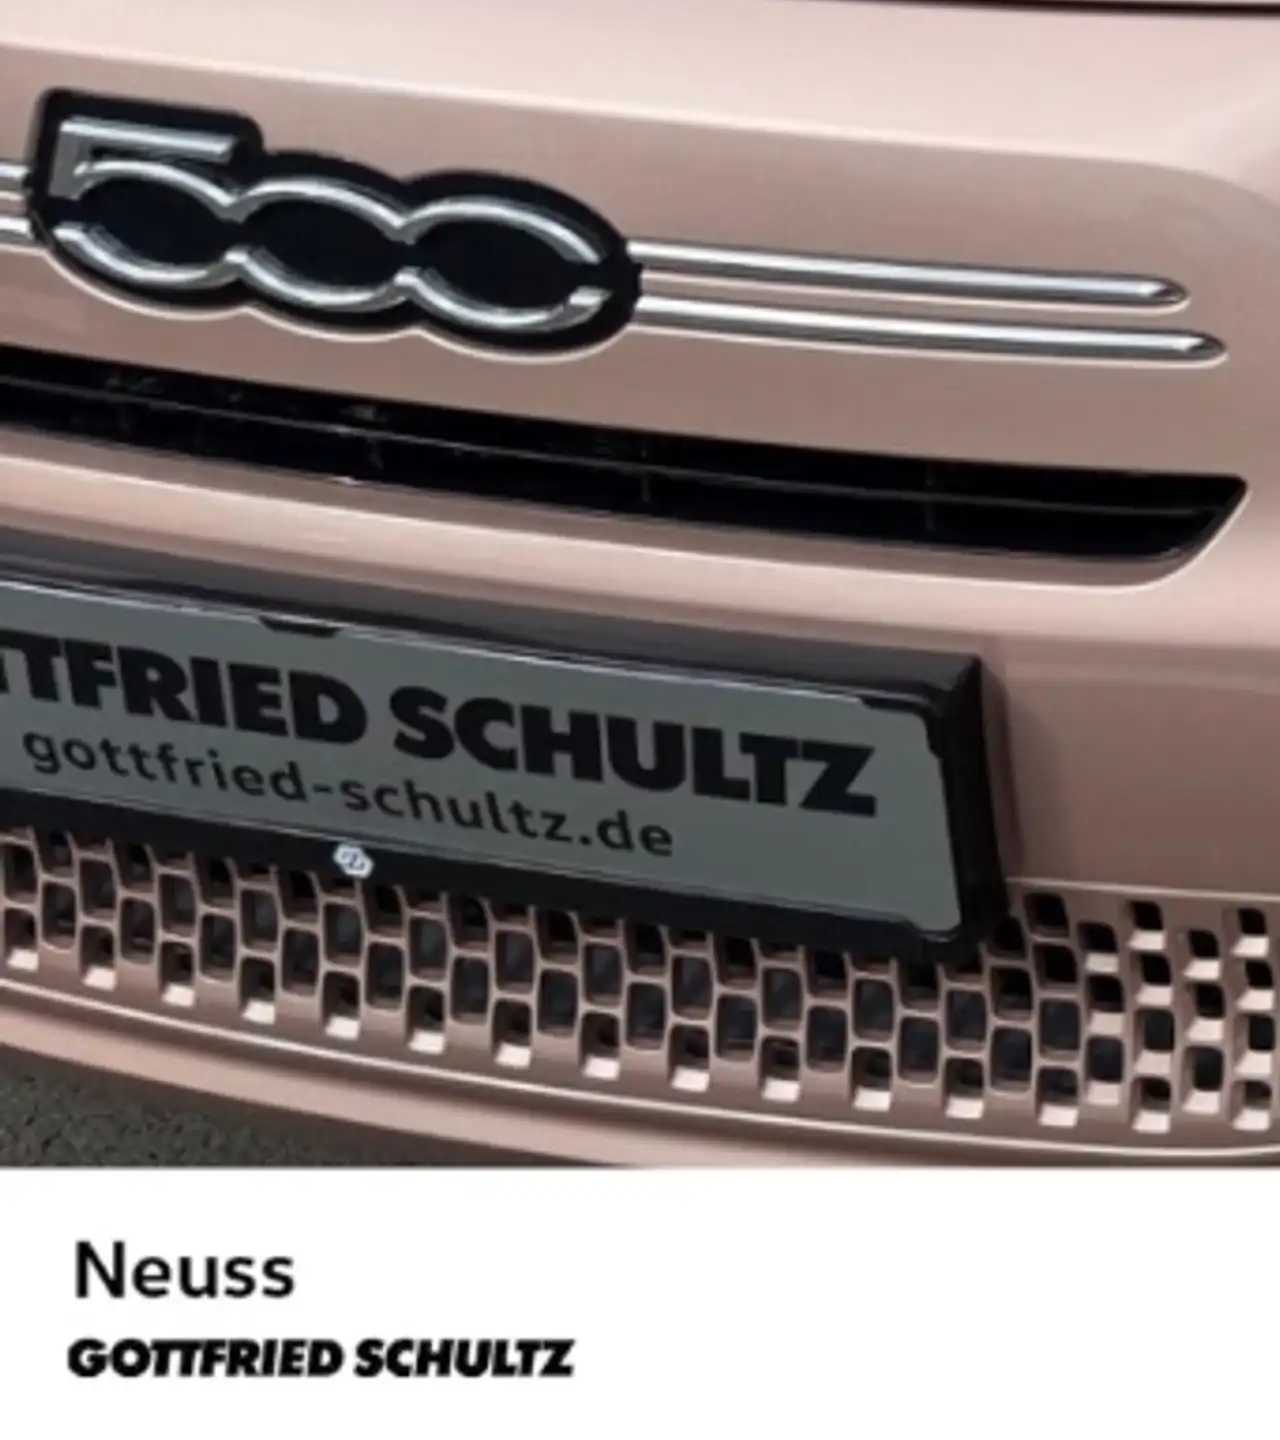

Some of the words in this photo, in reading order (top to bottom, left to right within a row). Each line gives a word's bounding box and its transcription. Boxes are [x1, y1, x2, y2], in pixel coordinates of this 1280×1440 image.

[48, 114, 614, 334] 500
[22, 730, 674, 858] gottfried-schultz.de
[389, 685, 878, 818] SCHULTZ
